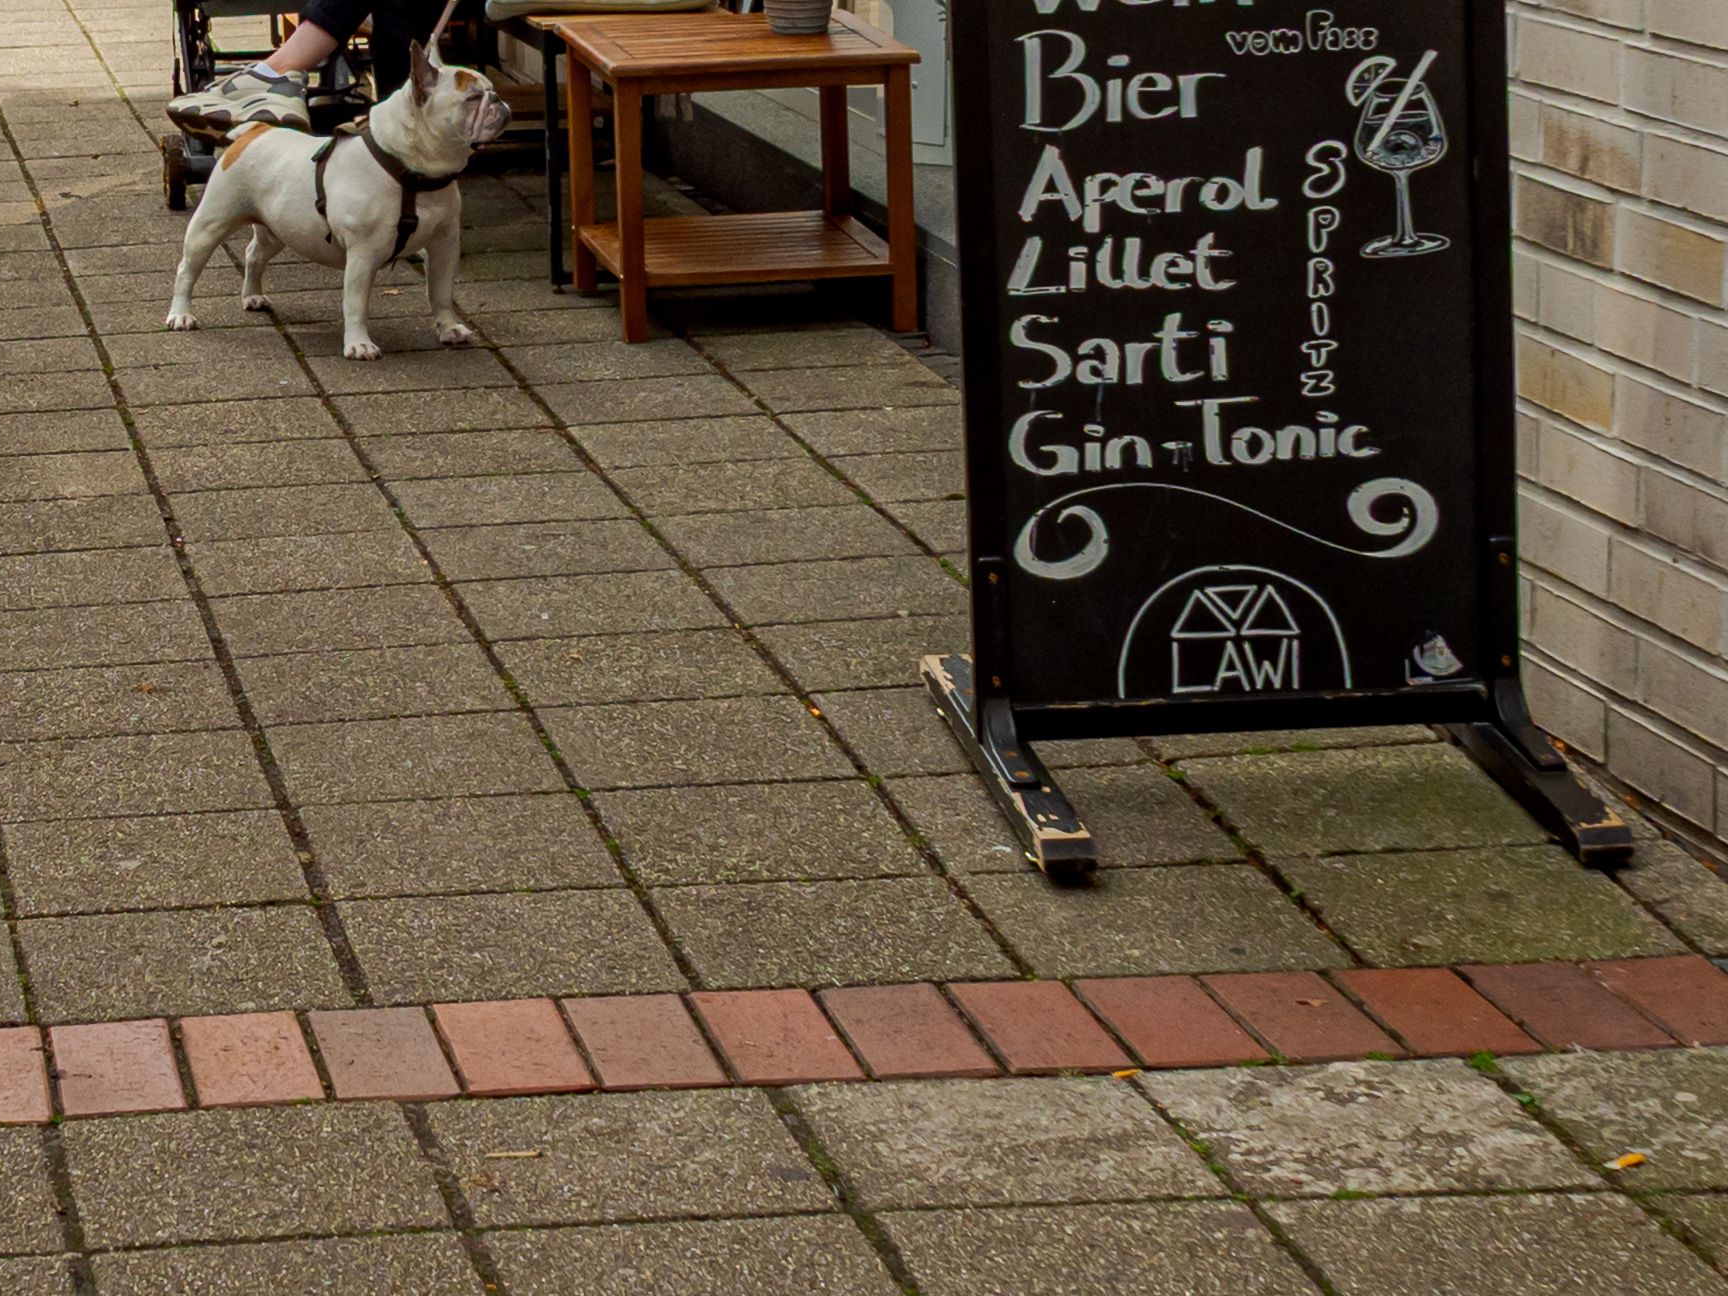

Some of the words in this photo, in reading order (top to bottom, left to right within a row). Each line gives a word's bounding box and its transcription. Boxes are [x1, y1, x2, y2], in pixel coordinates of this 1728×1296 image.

[1014, 29, 1227, 132] Bier
[1225, 28, 1304, 56] vom
[1018, 144, 1279, 234] Aperol
[1007, 232, 1239, 296] Lillet
[1300, 139, 1348, 398] SPRITZ
[1009, 312, 1235, 390] Sarti
[1171, 637, 1300, 694] LAWI
